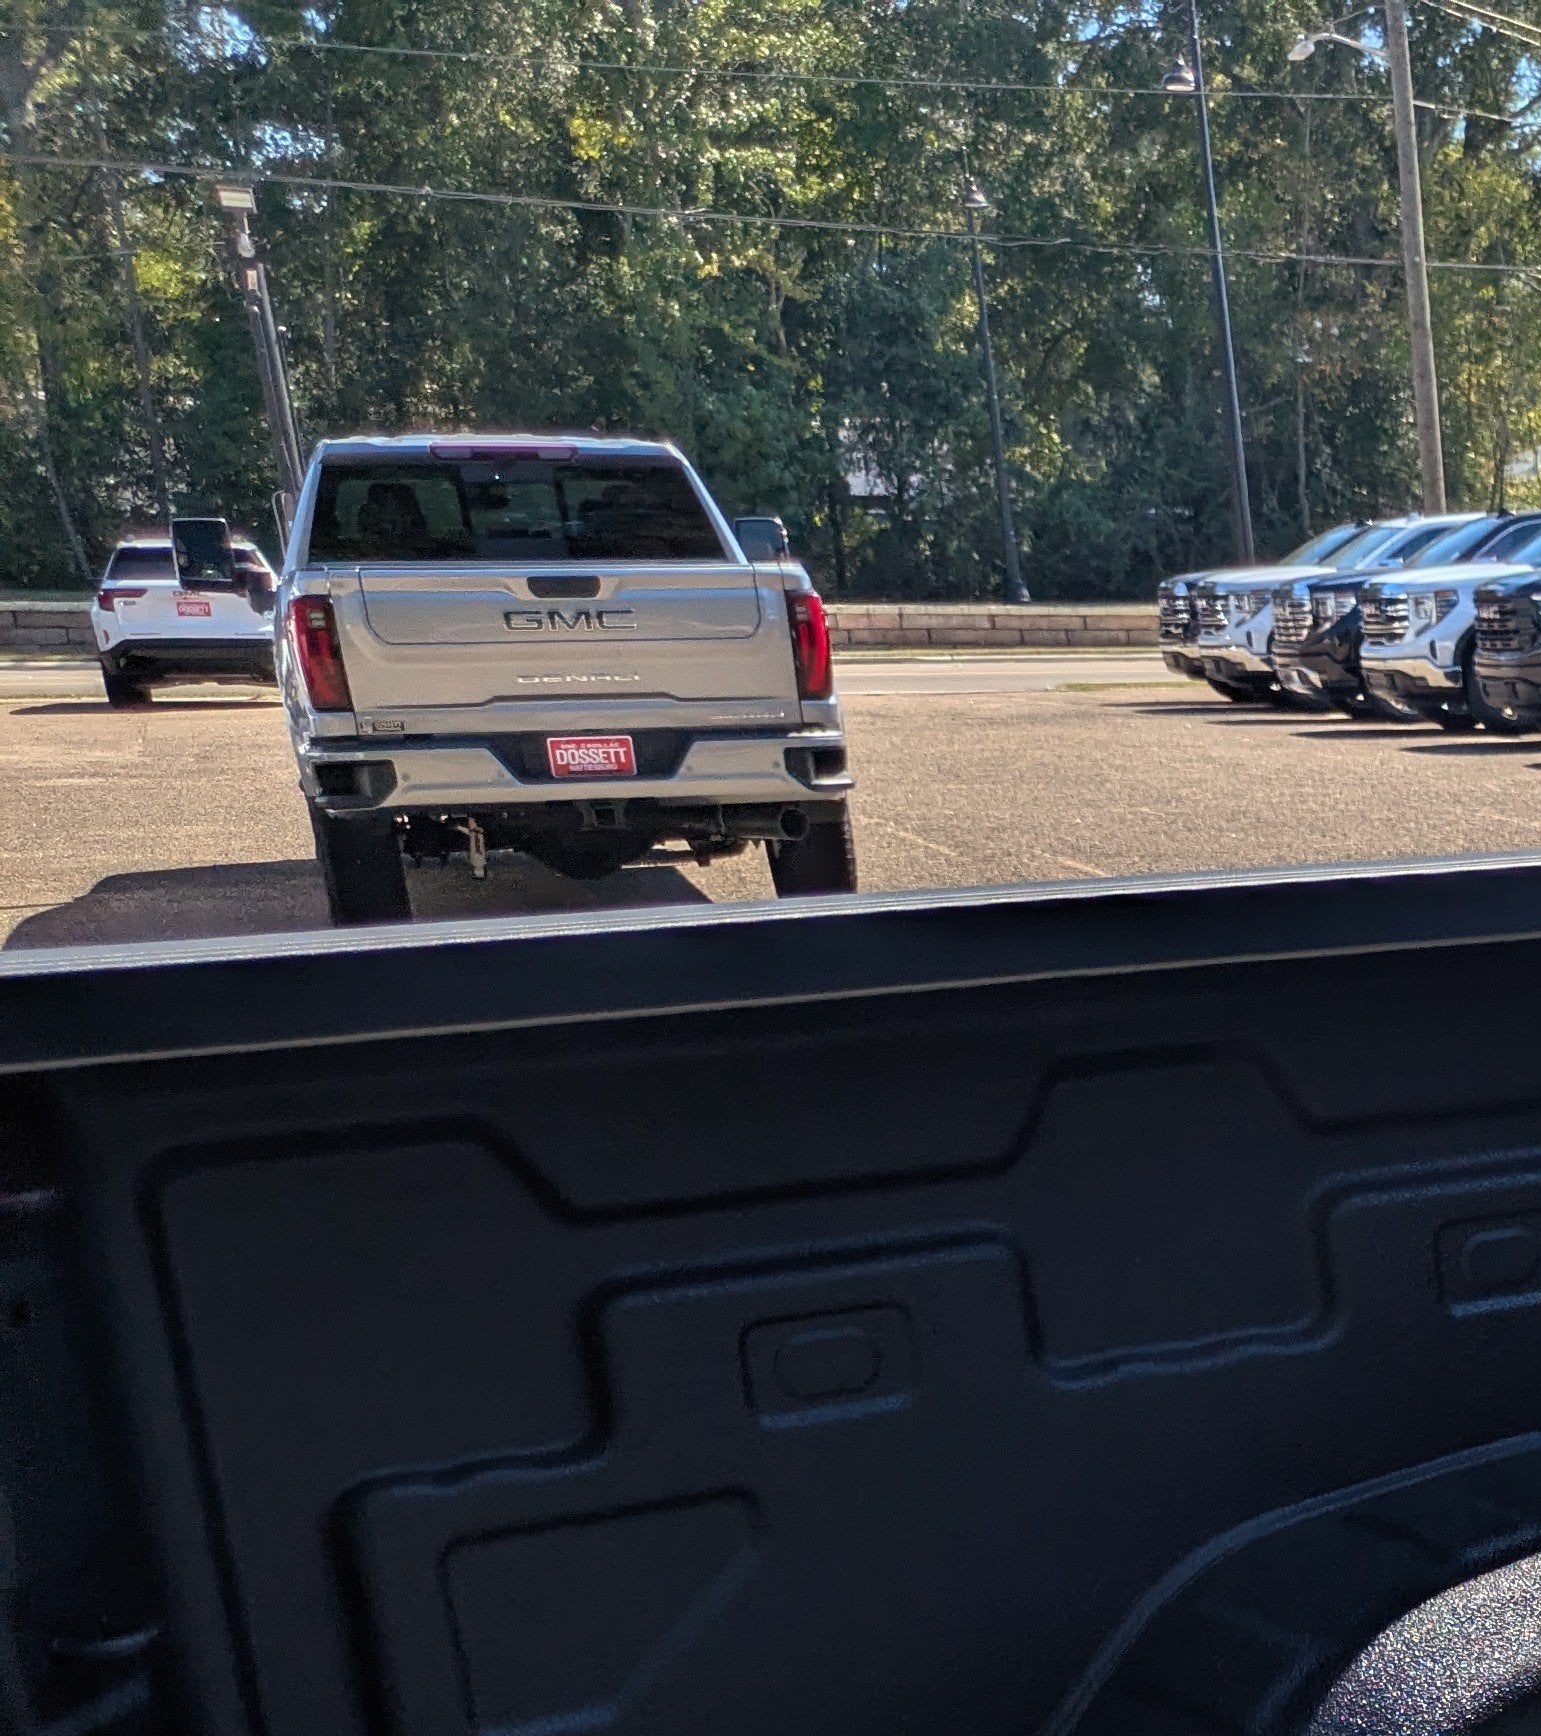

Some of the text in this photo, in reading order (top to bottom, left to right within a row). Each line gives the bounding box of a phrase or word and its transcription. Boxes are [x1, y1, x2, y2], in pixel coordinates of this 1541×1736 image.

[503, 609, 638, 632] GMC
[517, 673, 640, 684] DENALI
[555, 747, 627, 765] DOSSETT
